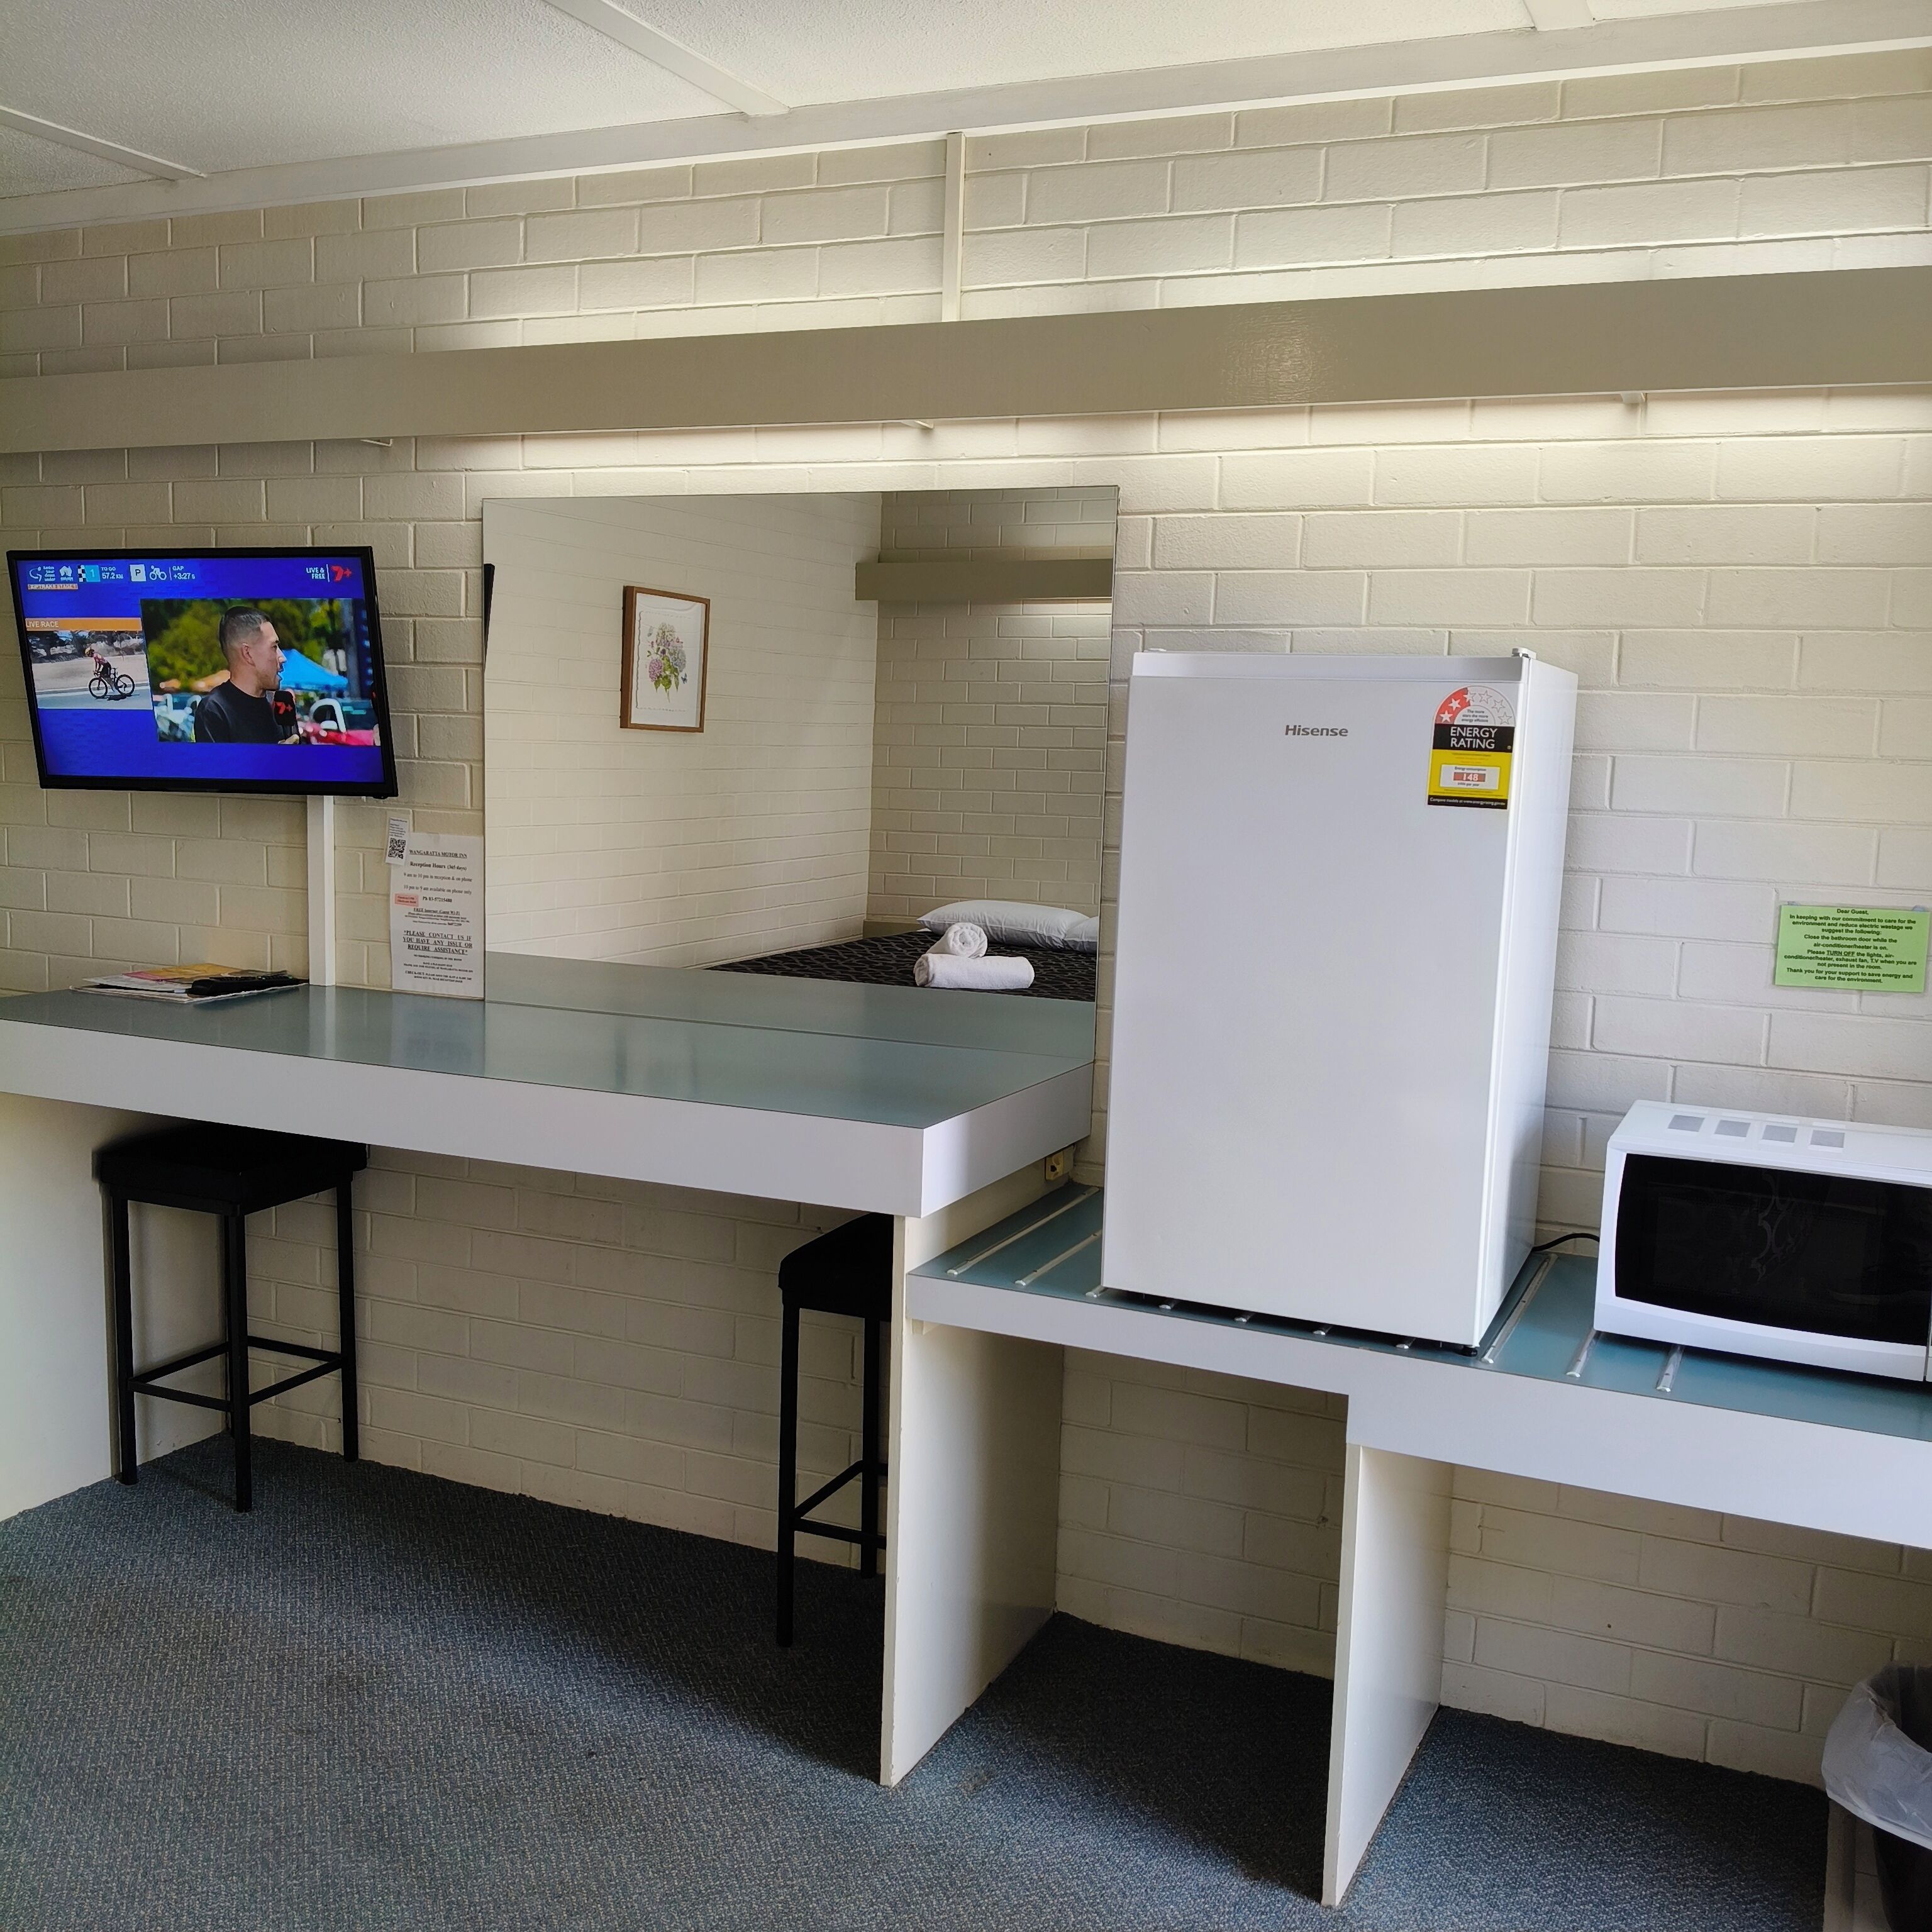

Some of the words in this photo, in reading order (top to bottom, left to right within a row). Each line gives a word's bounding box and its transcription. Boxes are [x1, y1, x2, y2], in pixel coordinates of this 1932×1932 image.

[1285, 725, 1348, 736] Hisense
[1450, 726, 1498, 738] ENERGY
[1450, 738, 1495, 749] RATING
